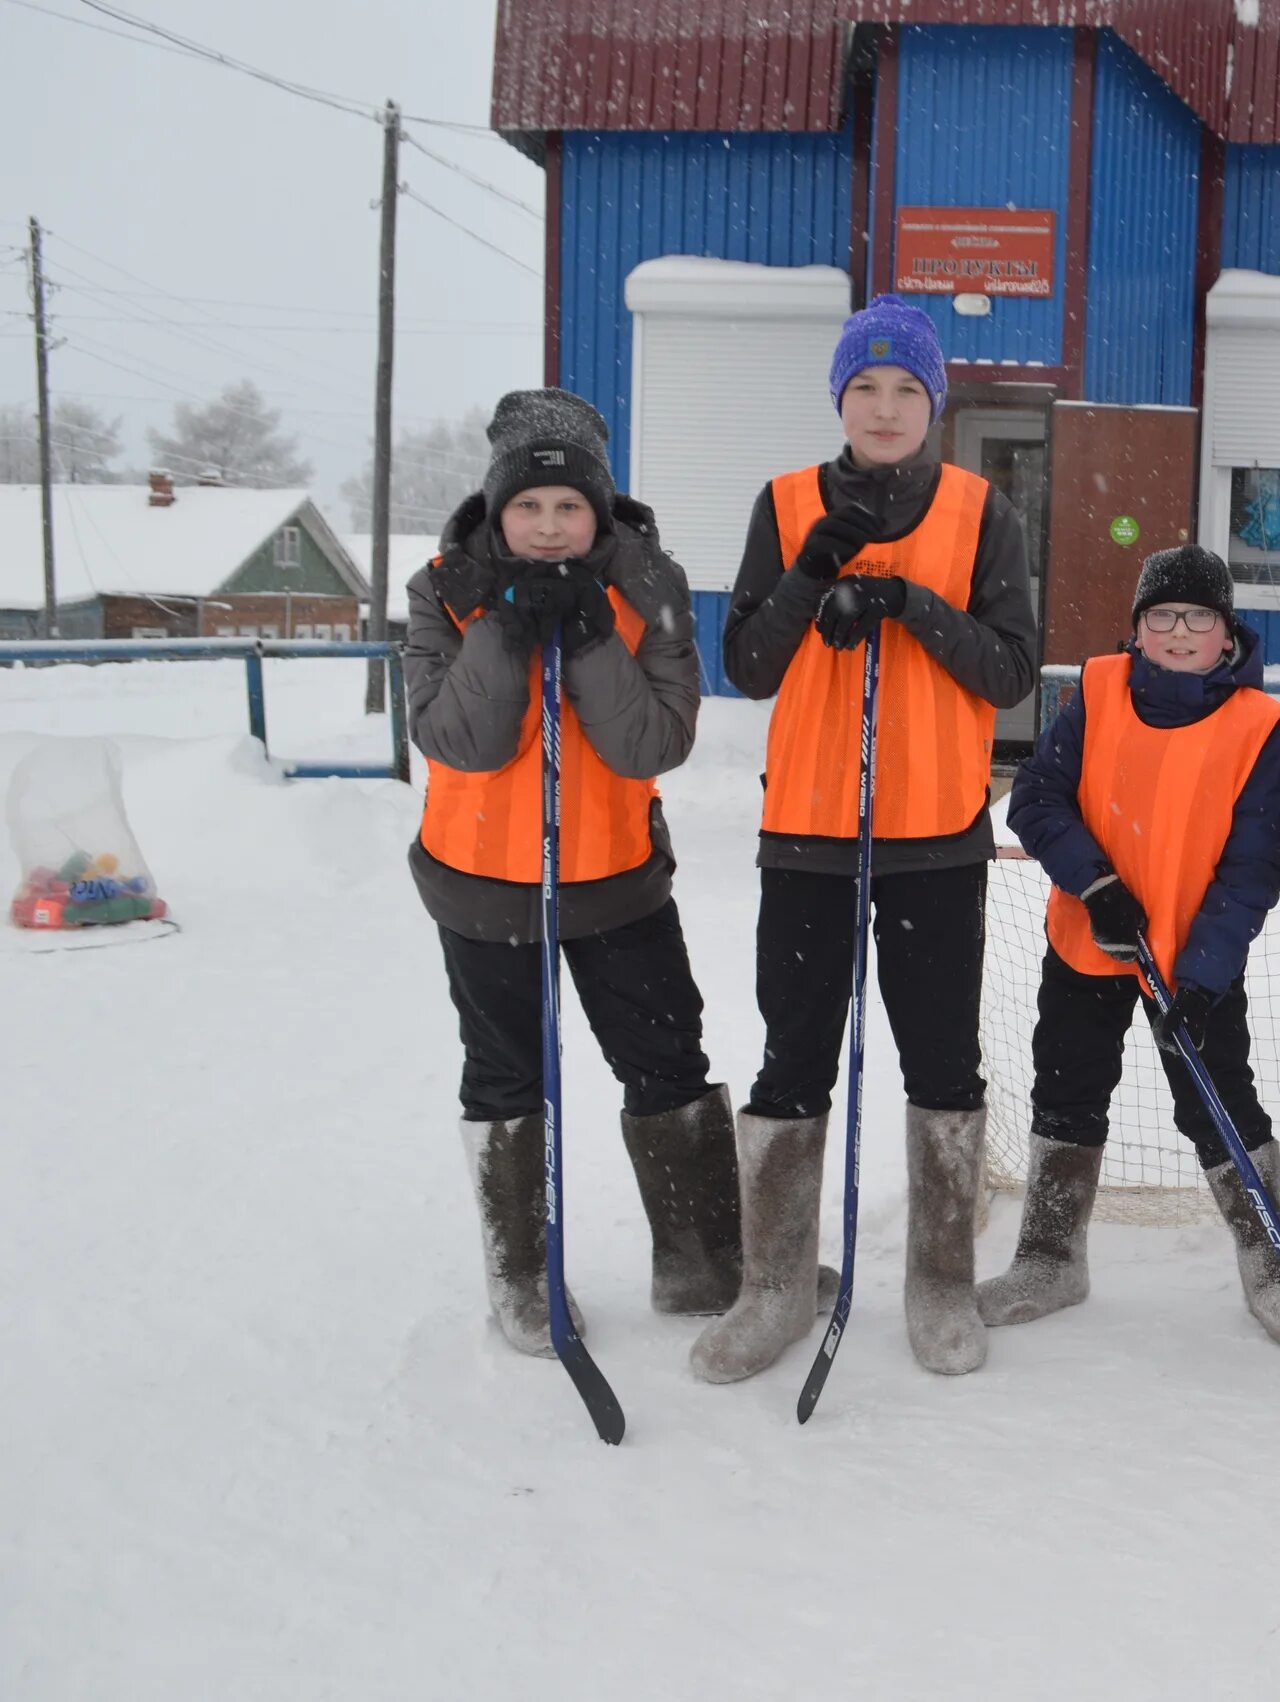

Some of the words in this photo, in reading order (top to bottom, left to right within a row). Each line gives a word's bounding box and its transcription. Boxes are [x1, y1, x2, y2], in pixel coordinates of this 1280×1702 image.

[912, 256, 1038, 277] ПРОДУКТЫ
[864, 642, 872, 699] FISCHER
[859, 771, 867, 817] W250
[543, 836, 552, 900] W250
[1146, 973, 1169, 1016] W25
[544, 1098, 556, 1225] FISCHER
